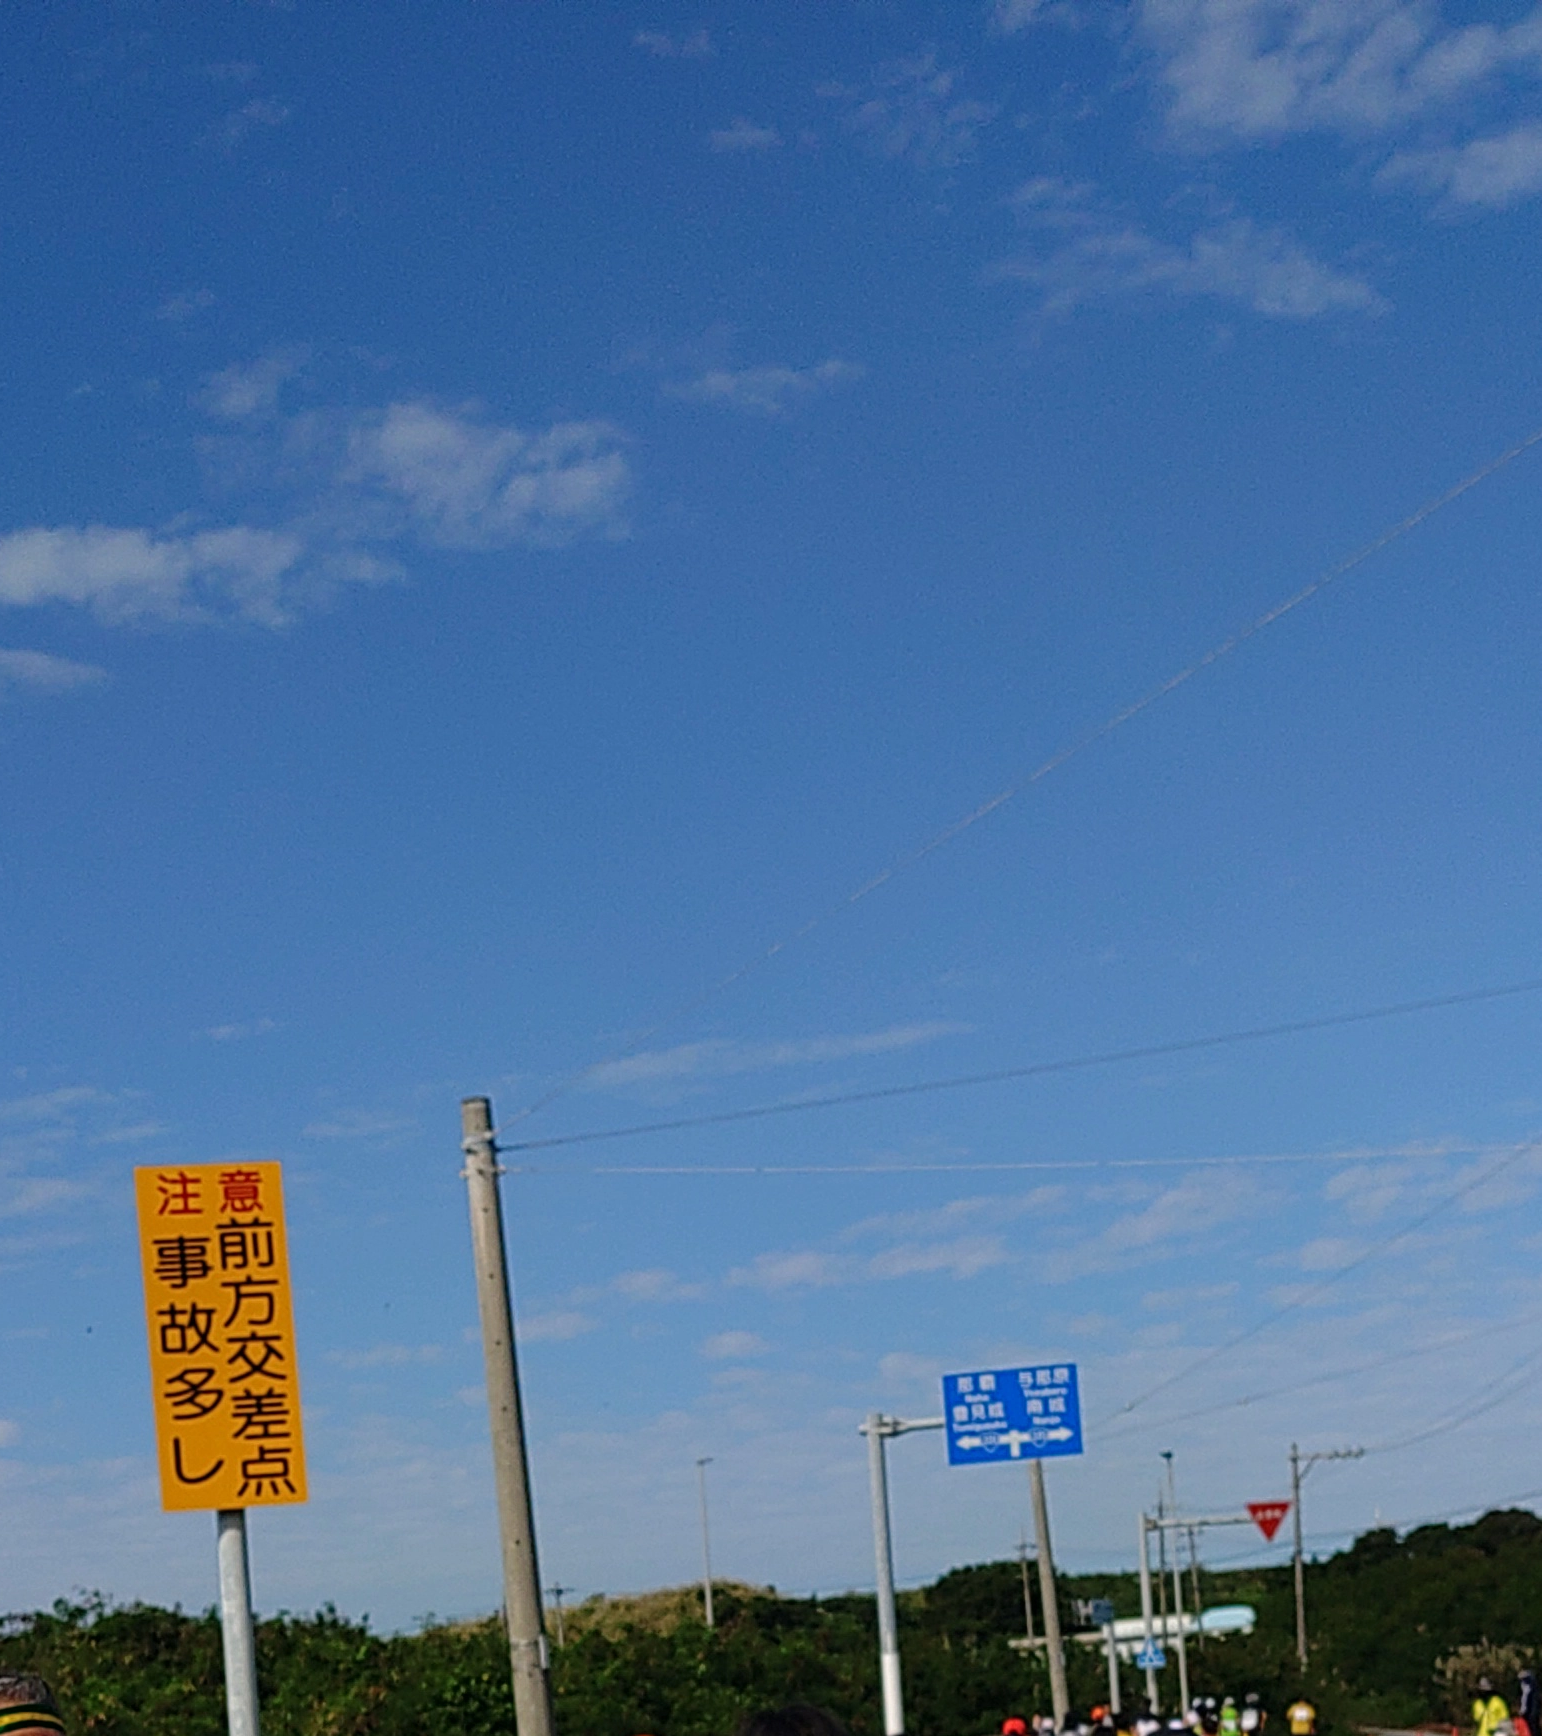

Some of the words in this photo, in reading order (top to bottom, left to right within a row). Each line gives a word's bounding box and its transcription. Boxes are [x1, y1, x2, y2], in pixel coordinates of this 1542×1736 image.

[157, 1169, 263, 1216] 注意
[151, 1234, 225, 1486] 事故多し
[214, 1217, 297, 1498] 前方交差点
